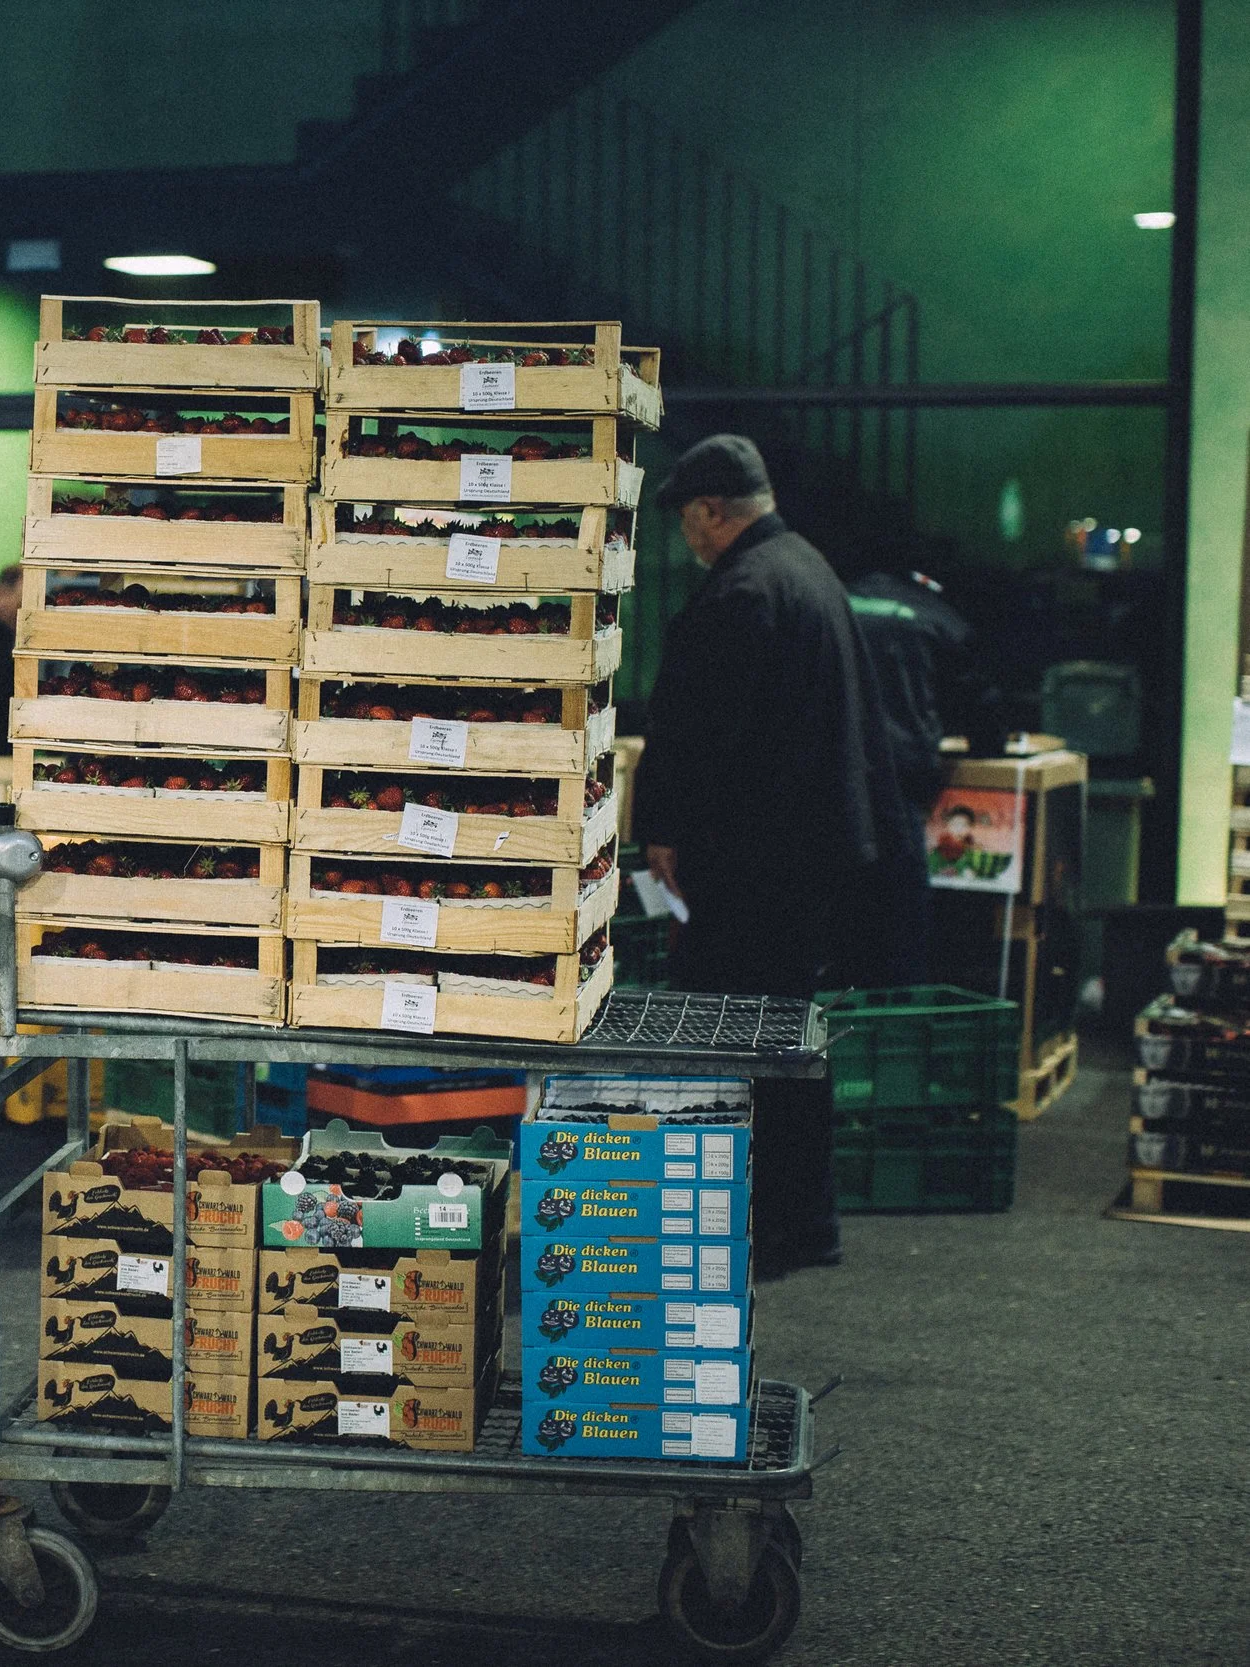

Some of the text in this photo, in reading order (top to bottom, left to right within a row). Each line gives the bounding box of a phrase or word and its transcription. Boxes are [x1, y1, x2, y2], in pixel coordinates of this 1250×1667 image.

[556, 1132, 630, 1143] Die dicken
[584, 1147, 640, 1160] Blauen
[553, 1188, 627, 1200] Die dicken
[582, 1204, 637, 1216] Blauen
[197, 1210, 243, 1225] FRUCHT
[553, 1245, 627, 1256] Die dicken
[582, 1260, 637, 1273] Blauen
[194, 1276, 240, 1291] FRUCHT
[417, 1288, 464, 1303] FRUCHT
[557, 1300, 631, 1312] Die dicken
[586, 1316, 641, 1328] Blauen
[192, 1336, 238, 1351] FRUCHT
[415, 1349, 462, 1364] FRUCHT
[556, 1357, 630, 1368] Die dicken
[584, 1372, 639, 1385] Blauen
[191, 1400, 236, 1415] FRUCHT
[554, 1410, 628, 1422] Die dicken
[416, 1416, 462, 1431] FRUCHT
[582, 1425, 638, 1439] Blauen
